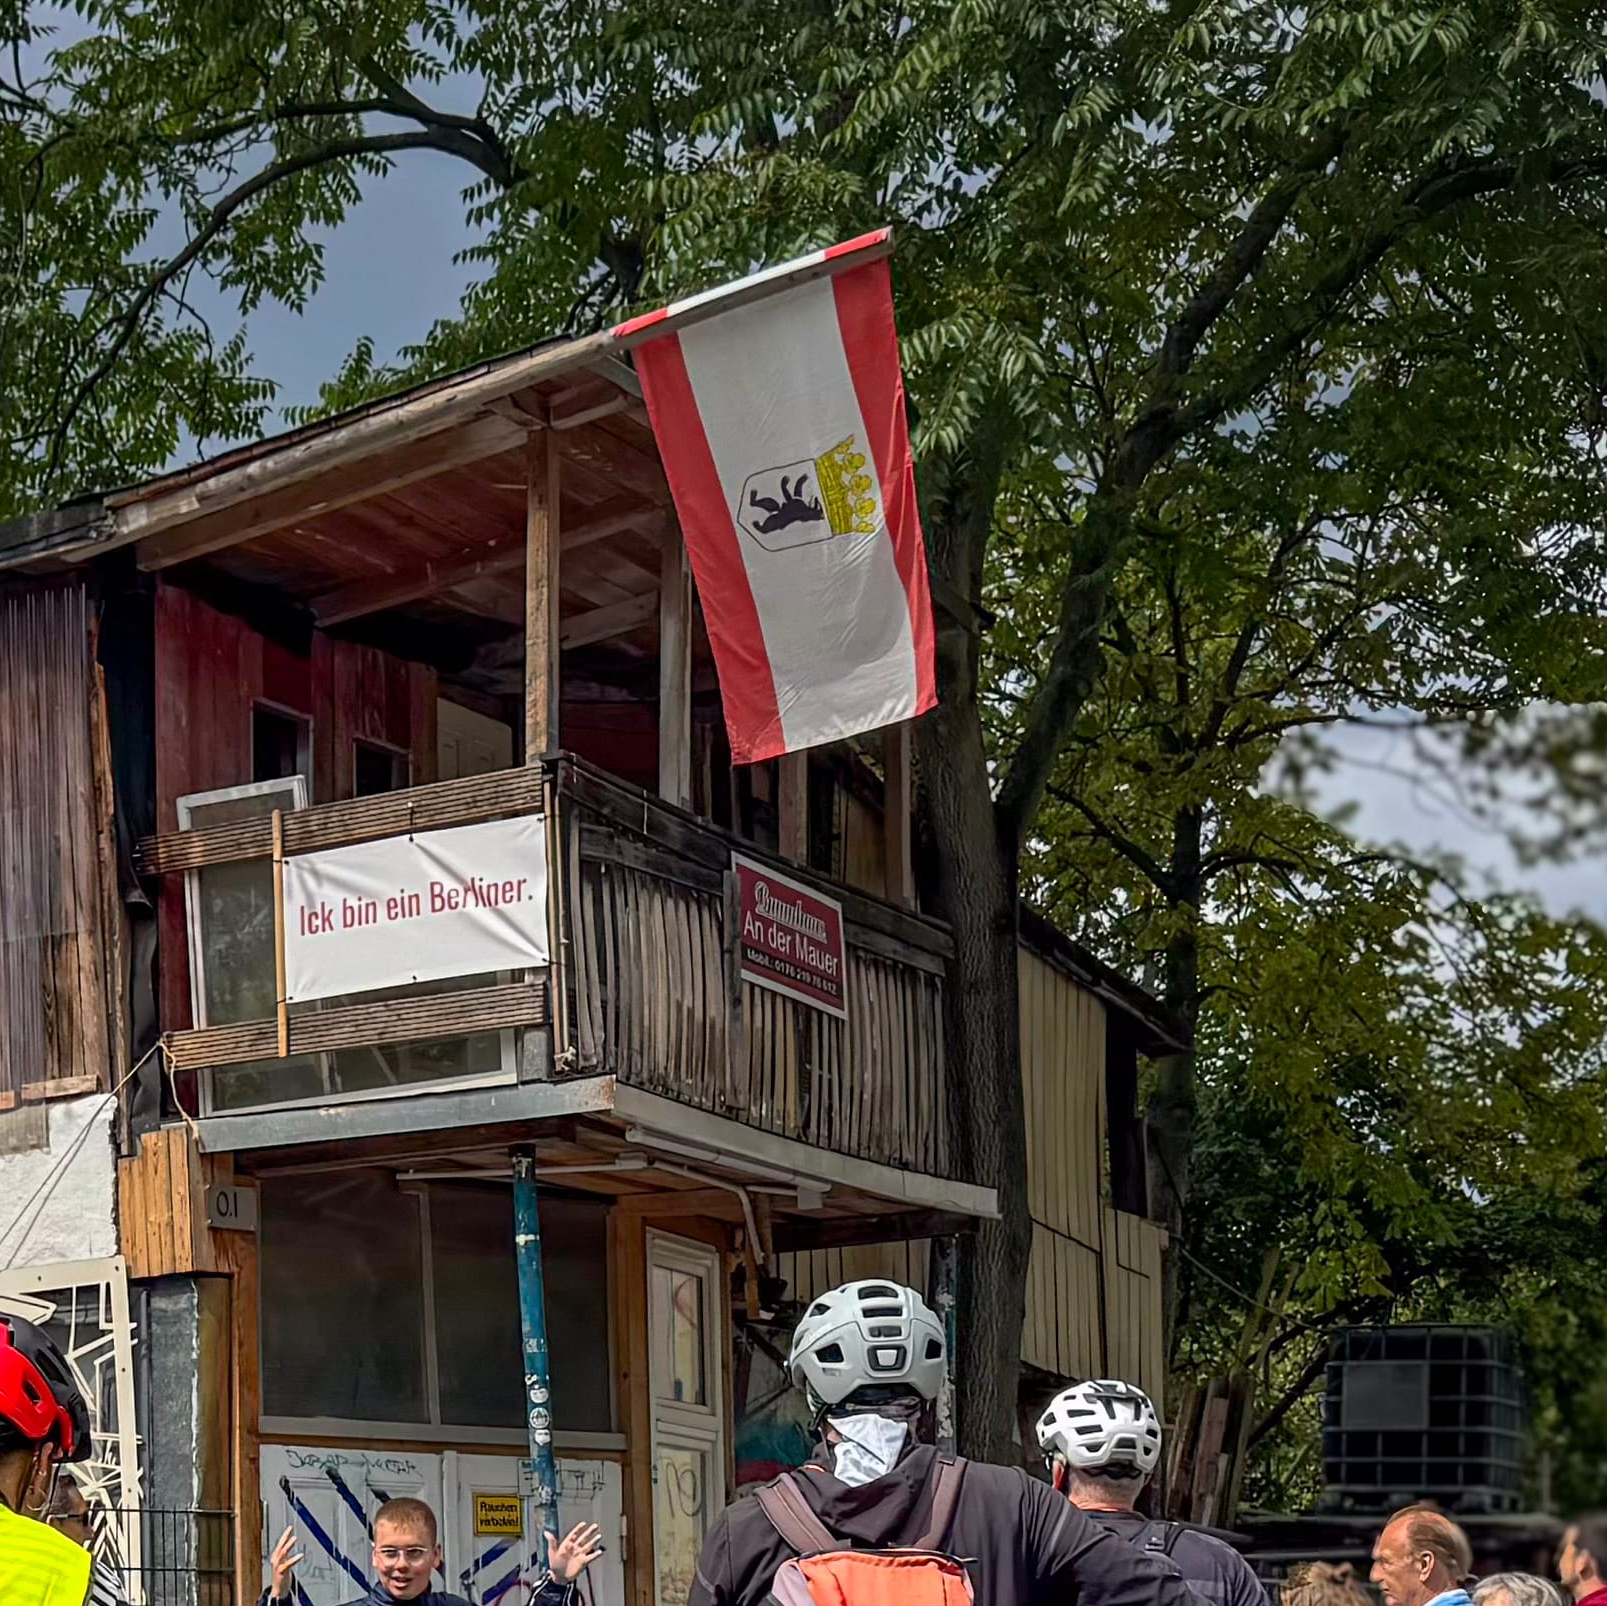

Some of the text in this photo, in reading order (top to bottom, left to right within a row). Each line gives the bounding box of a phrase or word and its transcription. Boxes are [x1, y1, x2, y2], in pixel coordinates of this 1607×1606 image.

[300, 877, 533, 936] Ick bin ein Berliner.
[744, 910, 838, 977] An der Mauer
